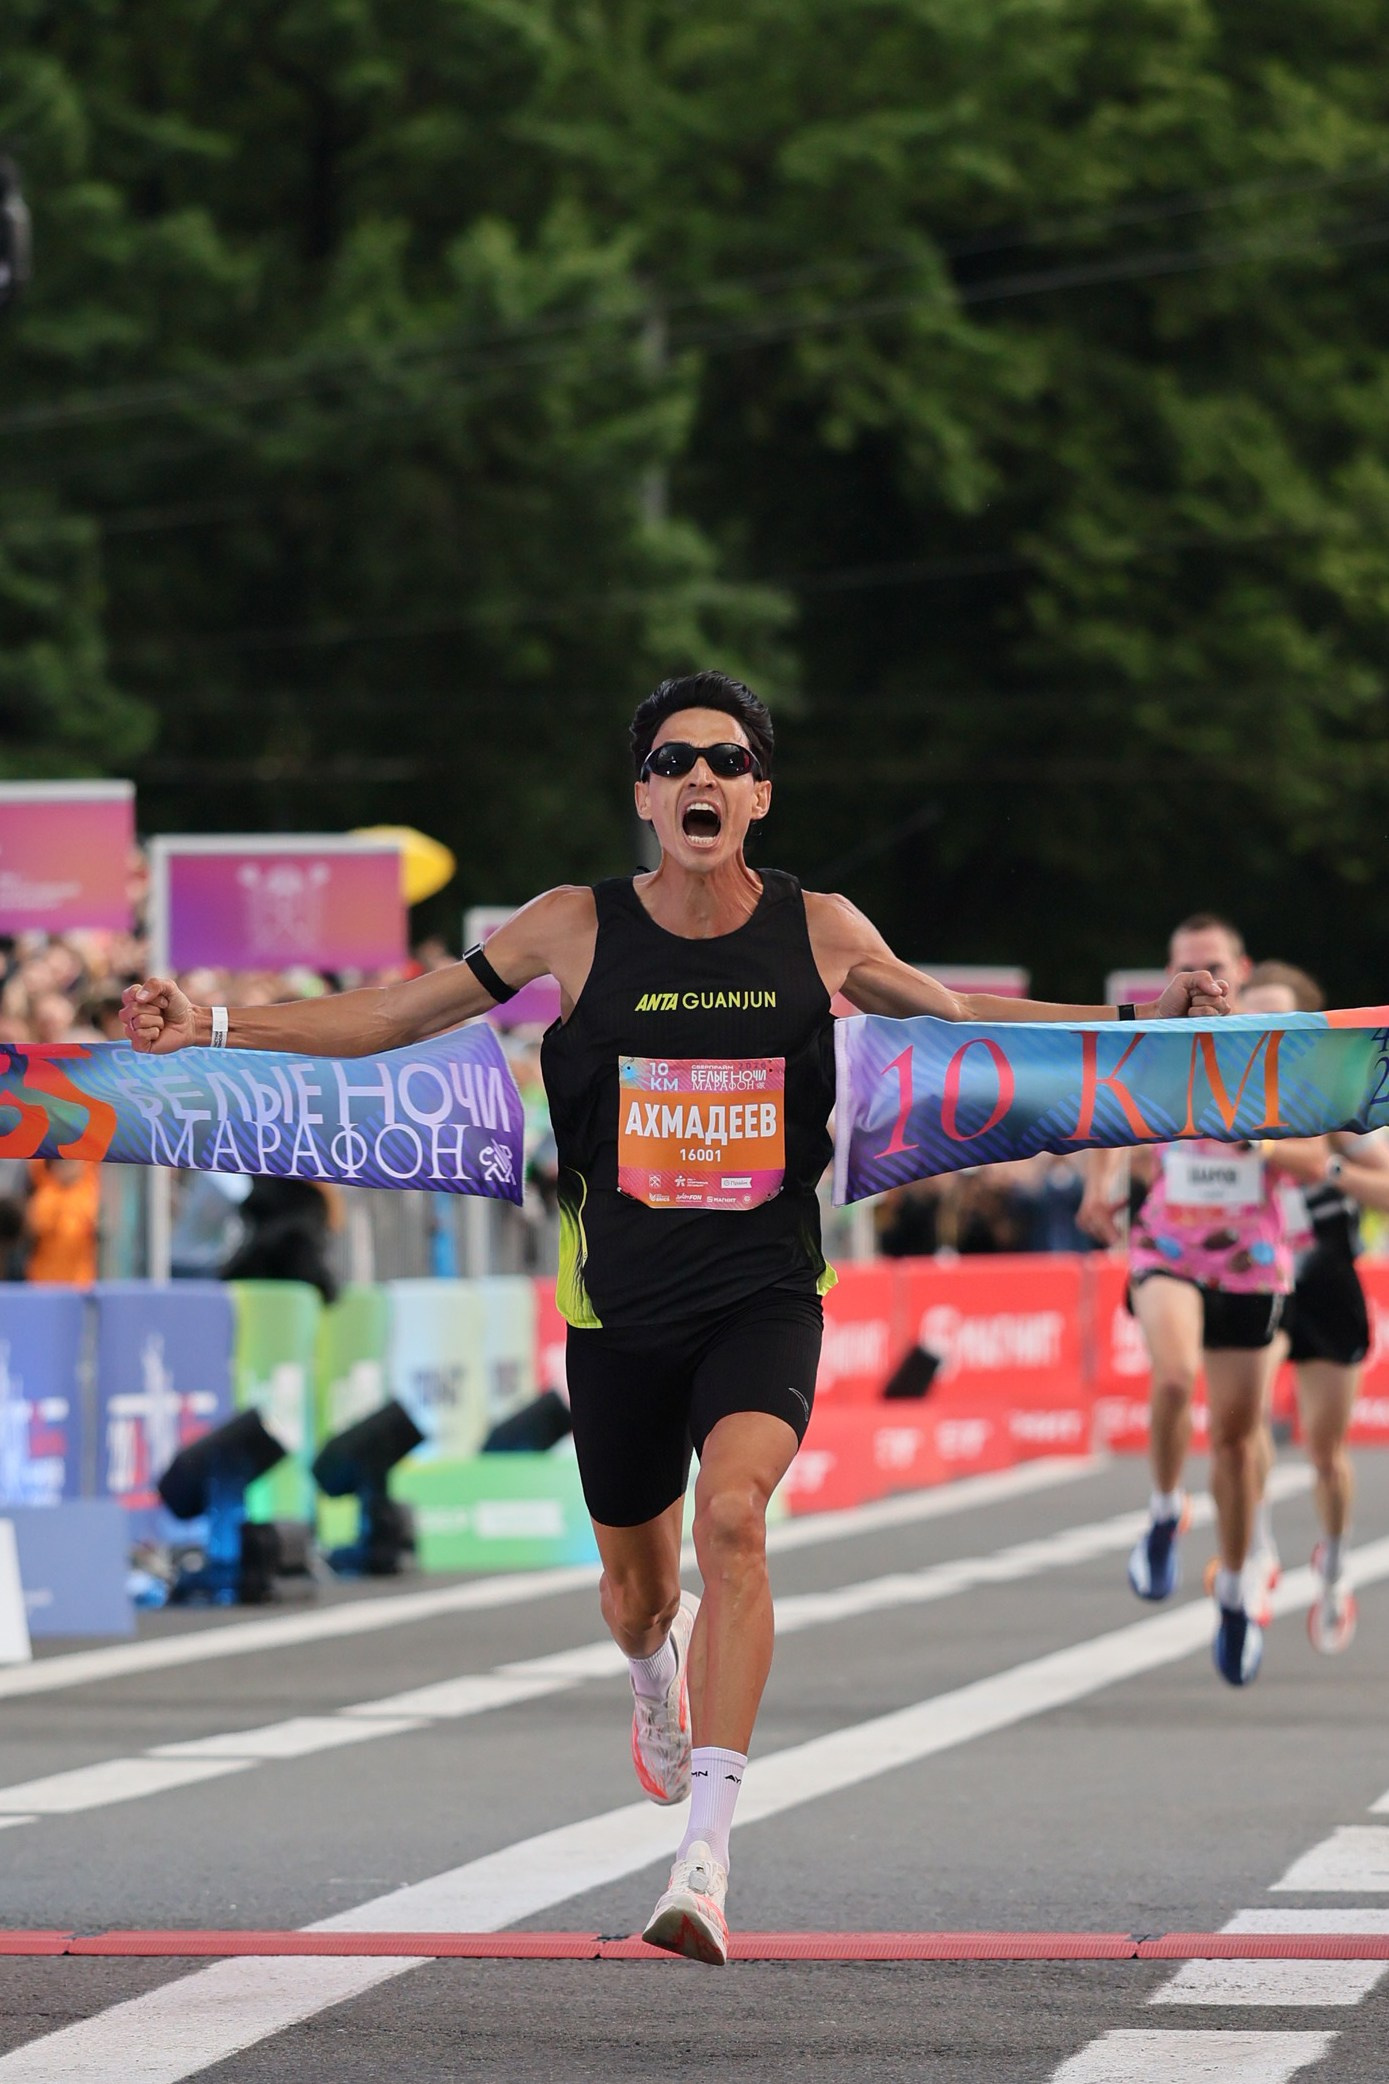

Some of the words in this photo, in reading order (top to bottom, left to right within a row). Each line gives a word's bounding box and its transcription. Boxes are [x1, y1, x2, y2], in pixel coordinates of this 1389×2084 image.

[634, 992, 679, 1012] ANTA
[682, 991, 777, 1010] GUANJUN
[649, 1062, 669, 1076] 10
[691, 1070, 729, 1083] БЕЛЫЕ
[730, 1069, 767, 1084] НОЧИ
[692, 1079, 755, 1091] МАРАФОН
[114, 1062, 324, 1124] БЕЛЫЕ
[331, 1061, 511, 1133] НОЧИ
[873, 1037, 1015, 1160] 10
[625, 1101, 777, 1146] АХМАДЕЕВ
[150, 1117, 473, 1180] МАРАФОН
[680, 1148, 721, 1162] 16001
